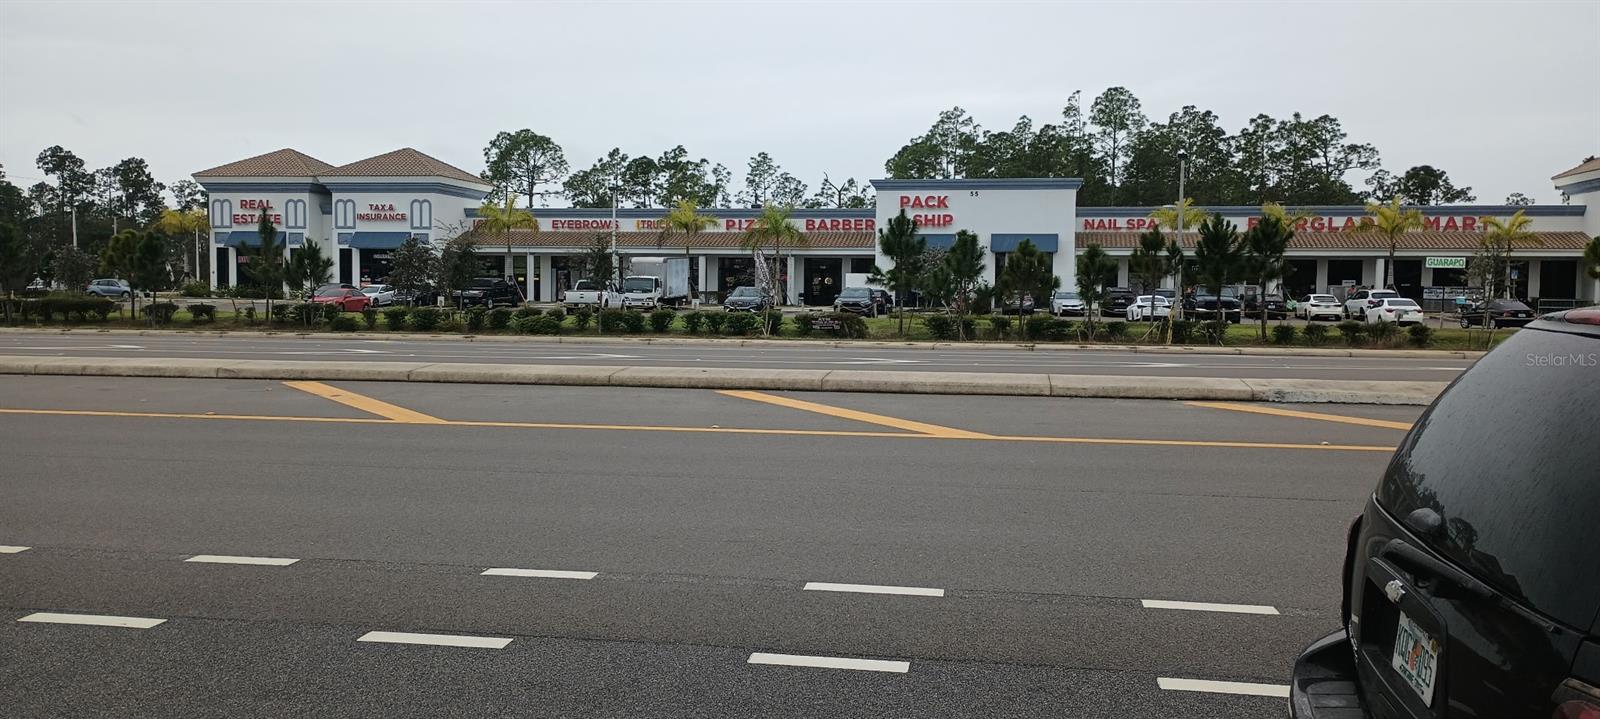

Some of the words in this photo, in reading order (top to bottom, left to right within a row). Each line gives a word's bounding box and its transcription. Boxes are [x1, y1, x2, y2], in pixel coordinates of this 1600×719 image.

[240, 199, 273, 209] REAL
[368, 203, 386, 211] TAX
[387, 203, 394, 211] &
[900, 195, 949, 209] PACK
[805, 218, 876, 231] BARBER
[913, 214, 954, 227] SHIP
[1084, 218, 1121, 230] NAIL
[1126, 218, 1157, 230] SPA
[1423, 216, 1491, 231] MART
[1427, 258, 1465, 267] GUARAPO
